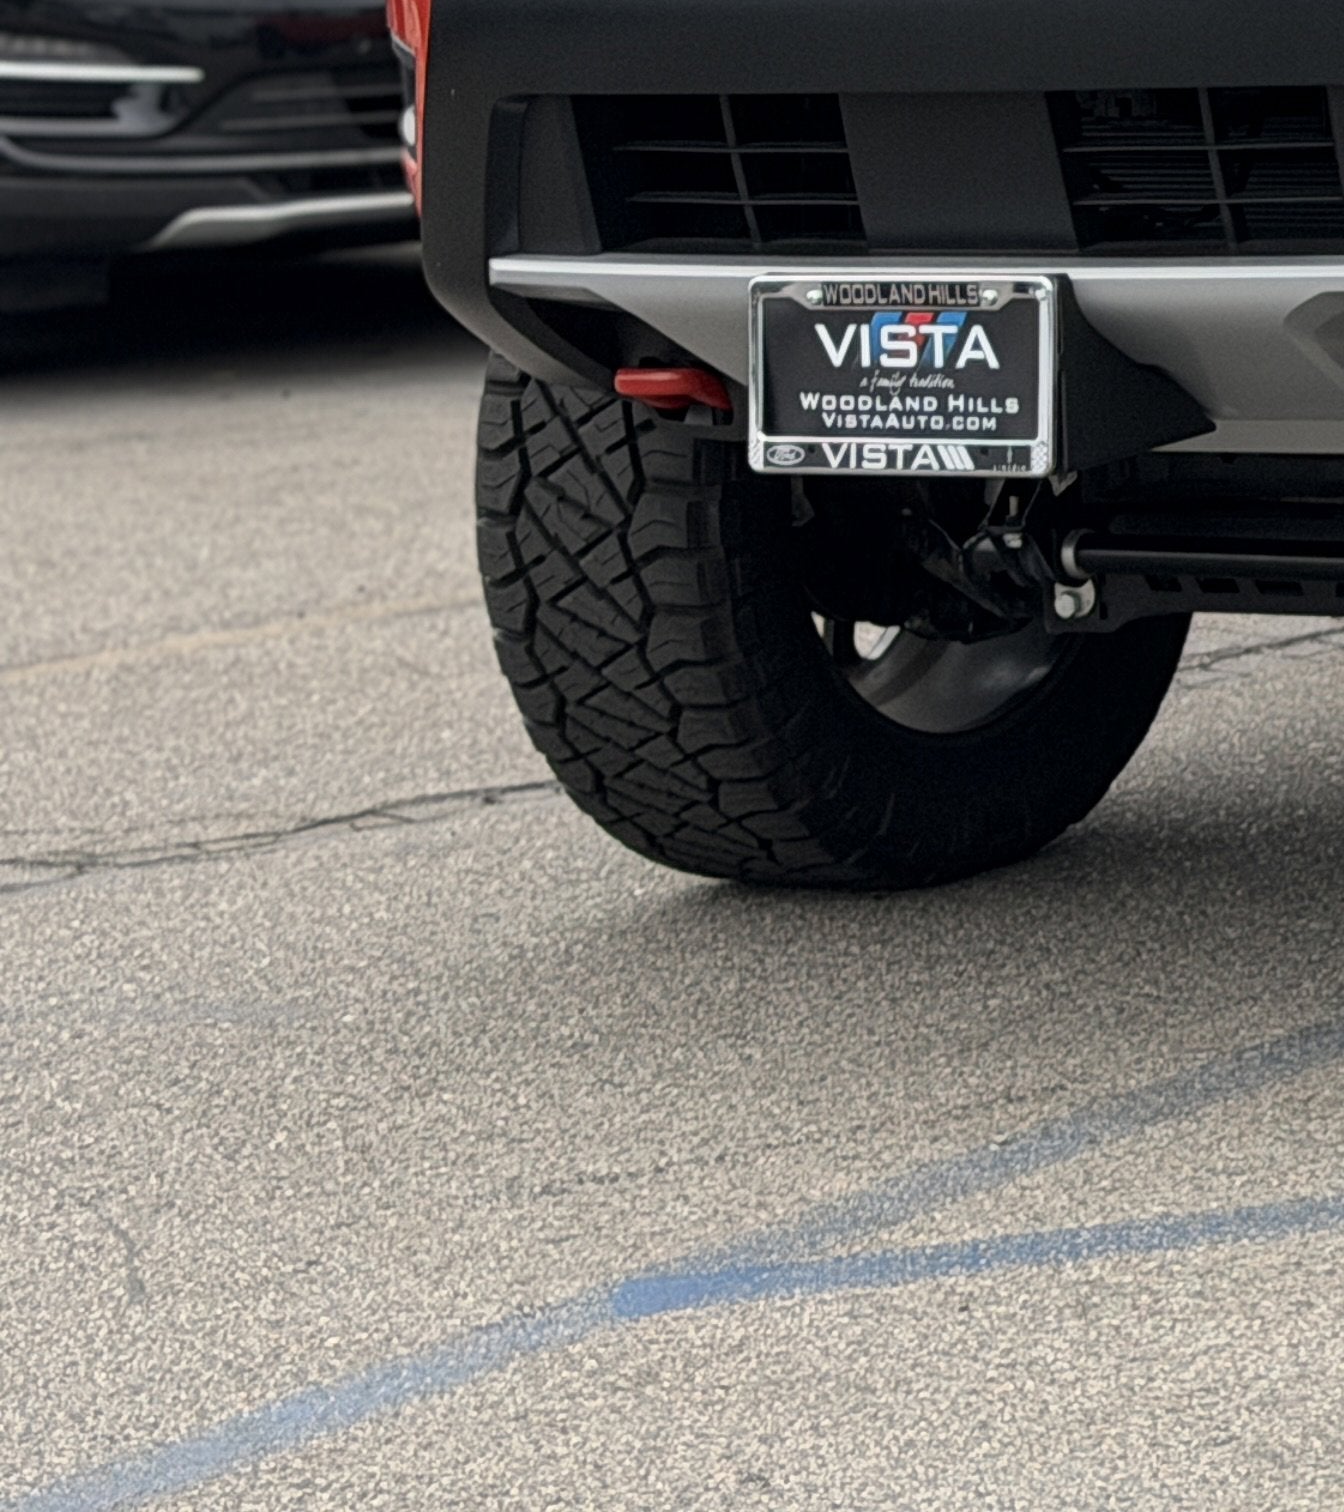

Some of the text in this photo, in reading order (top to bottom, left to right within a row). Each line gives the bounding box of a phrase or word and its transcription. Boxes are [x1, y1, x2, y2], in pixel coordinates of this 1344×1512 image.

[823, 284, 979, 305] WOODLAND HILLS
[815, 323, 1000, 369] VISTA
[800, 391, 1019, 414] WOODLAND HILLS
[822, 443, 940, 470] VISTA
